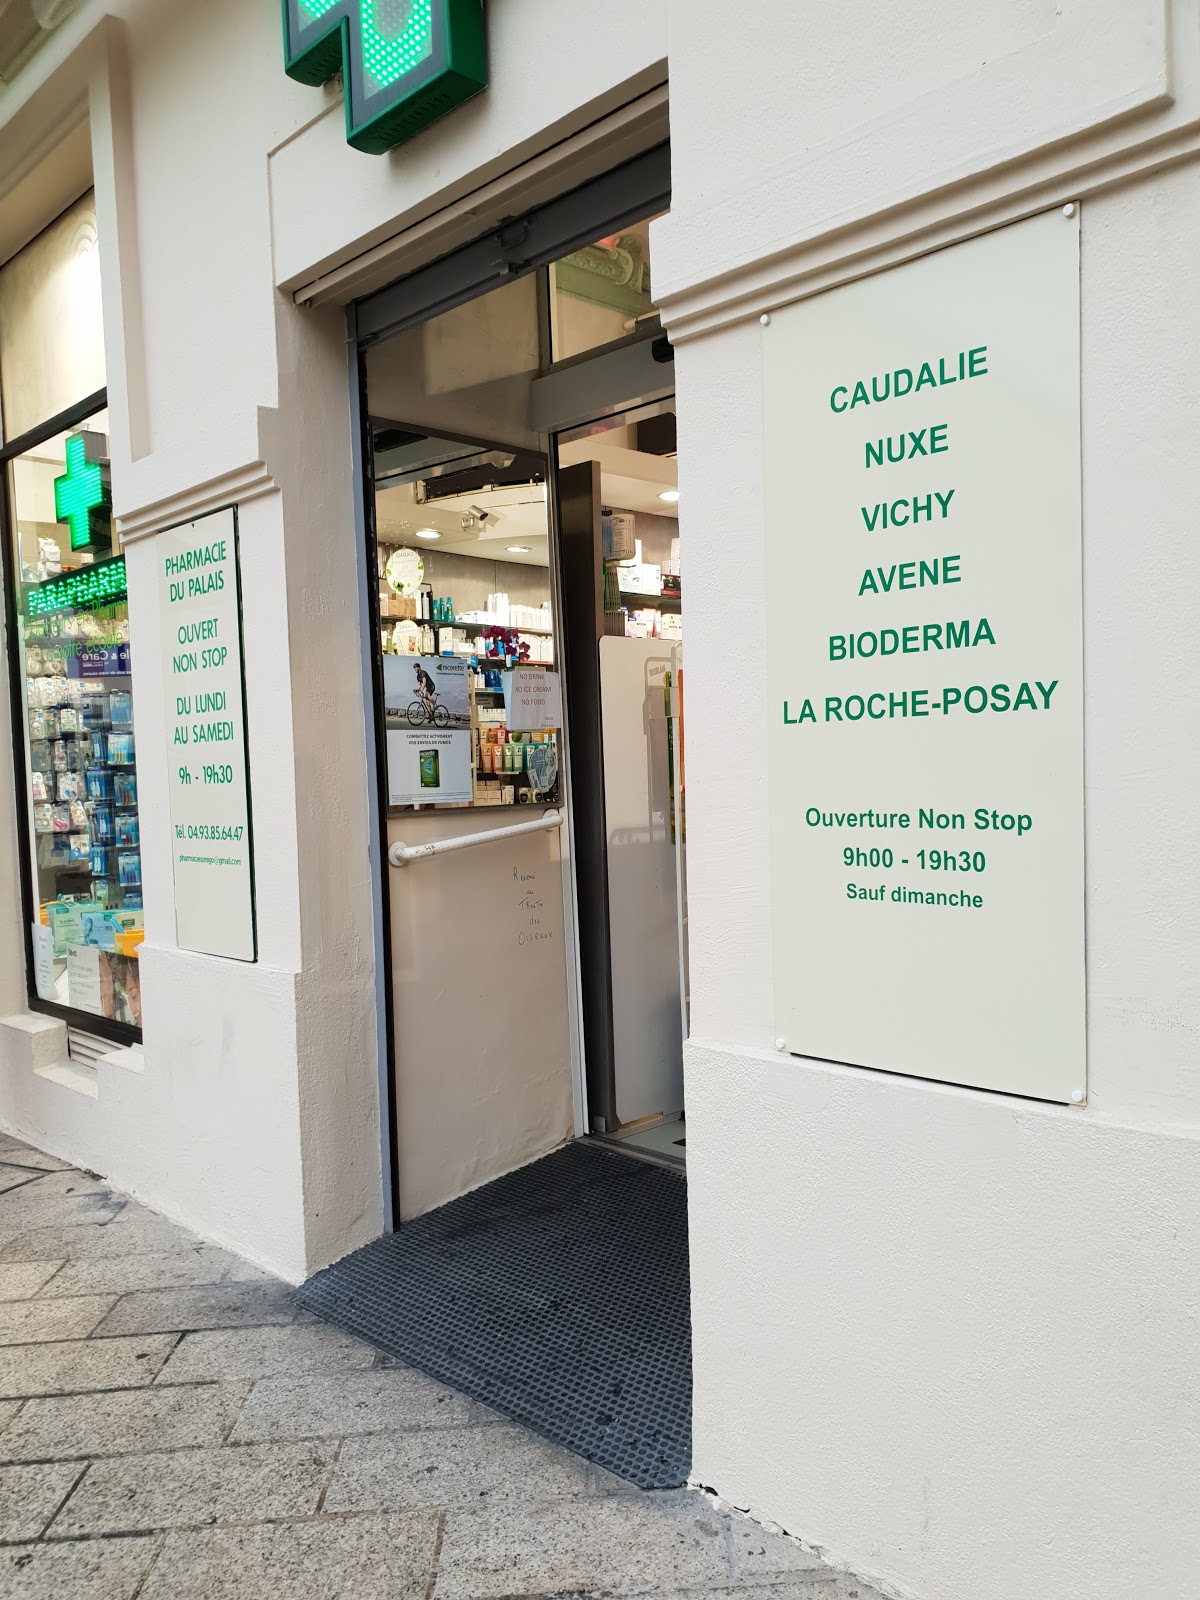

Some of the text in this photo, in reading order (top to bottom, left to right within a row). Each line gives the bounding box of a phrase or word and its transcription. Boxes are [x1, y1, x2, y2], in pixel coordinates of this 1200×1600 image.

[829, 345, 989, 414] CAUDALIE
[864, 423, 949, 469] NUXE
[860, 488, 956, 532] VICHY
[165, 540, 227, 578] PHARMACIE
[169, 570, 225, 603] DU PALAIS
[858, 554, 962, 597] AVENE
[178, 618, 219, 645] OUVERT
[829, 617, 997, 662] BIODERMA
[173, 646, 228, 674] NON STOP
[176, 691, 227, 716] DU LUNDI
[783, 680, 1059, 725] LA ROCHE-POSAY
[174, 721, 234, 745] AU SAMEDI
[178, 766, 192, 785] 9h
[202, 763, 233, 785] 19h30
[175, 824, 244, 841] Tél. 04.93.85.64.47
[805, 807, 1033, 836] Ouverture Non Stop
[843, 847, 894, 869] 9h00
[916, 849, 987, 873] 19h30
[846, 883, 984, 908] Sauf dimanche
